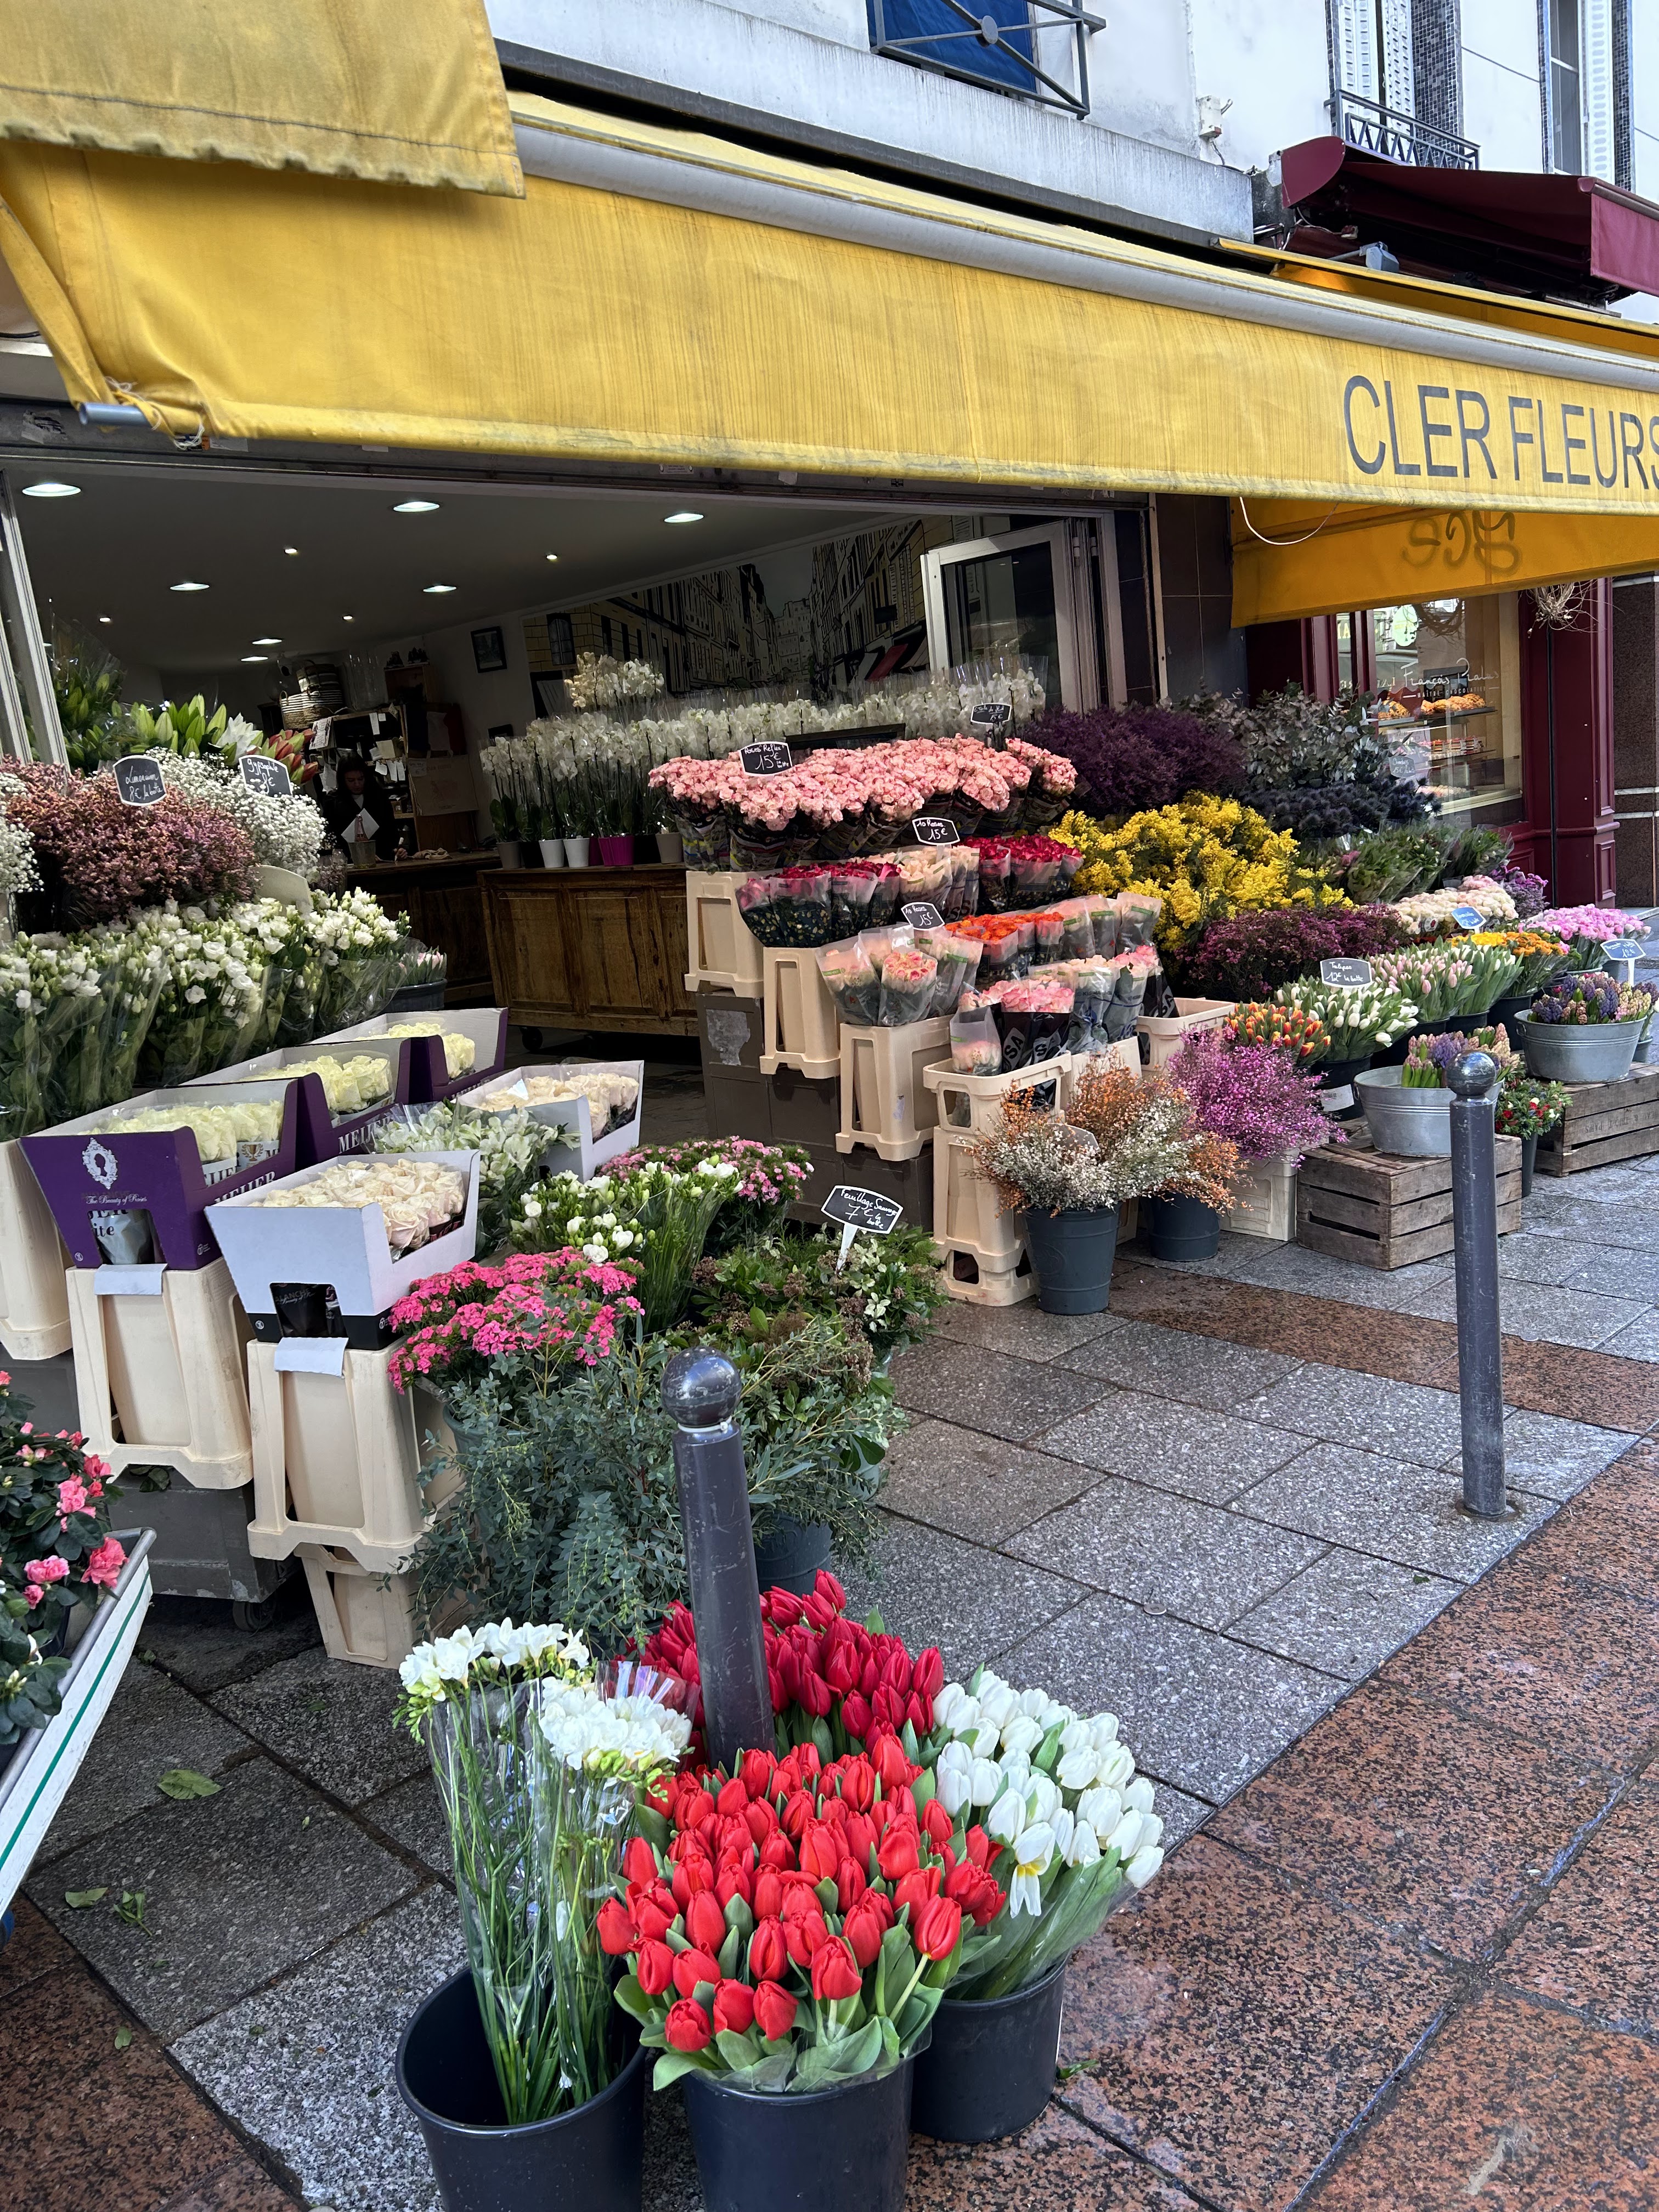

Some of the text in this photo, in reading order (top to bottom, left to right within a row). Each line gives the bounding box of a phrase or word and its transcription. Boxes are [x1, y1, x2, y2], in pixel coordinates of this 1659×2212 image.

[1344, 375, 1498, 479] CLER
[86, 1195, 98, 1205] The
[99, 1195, 121, 1206] Beauty
[122, 1196, 127, 1205] of
